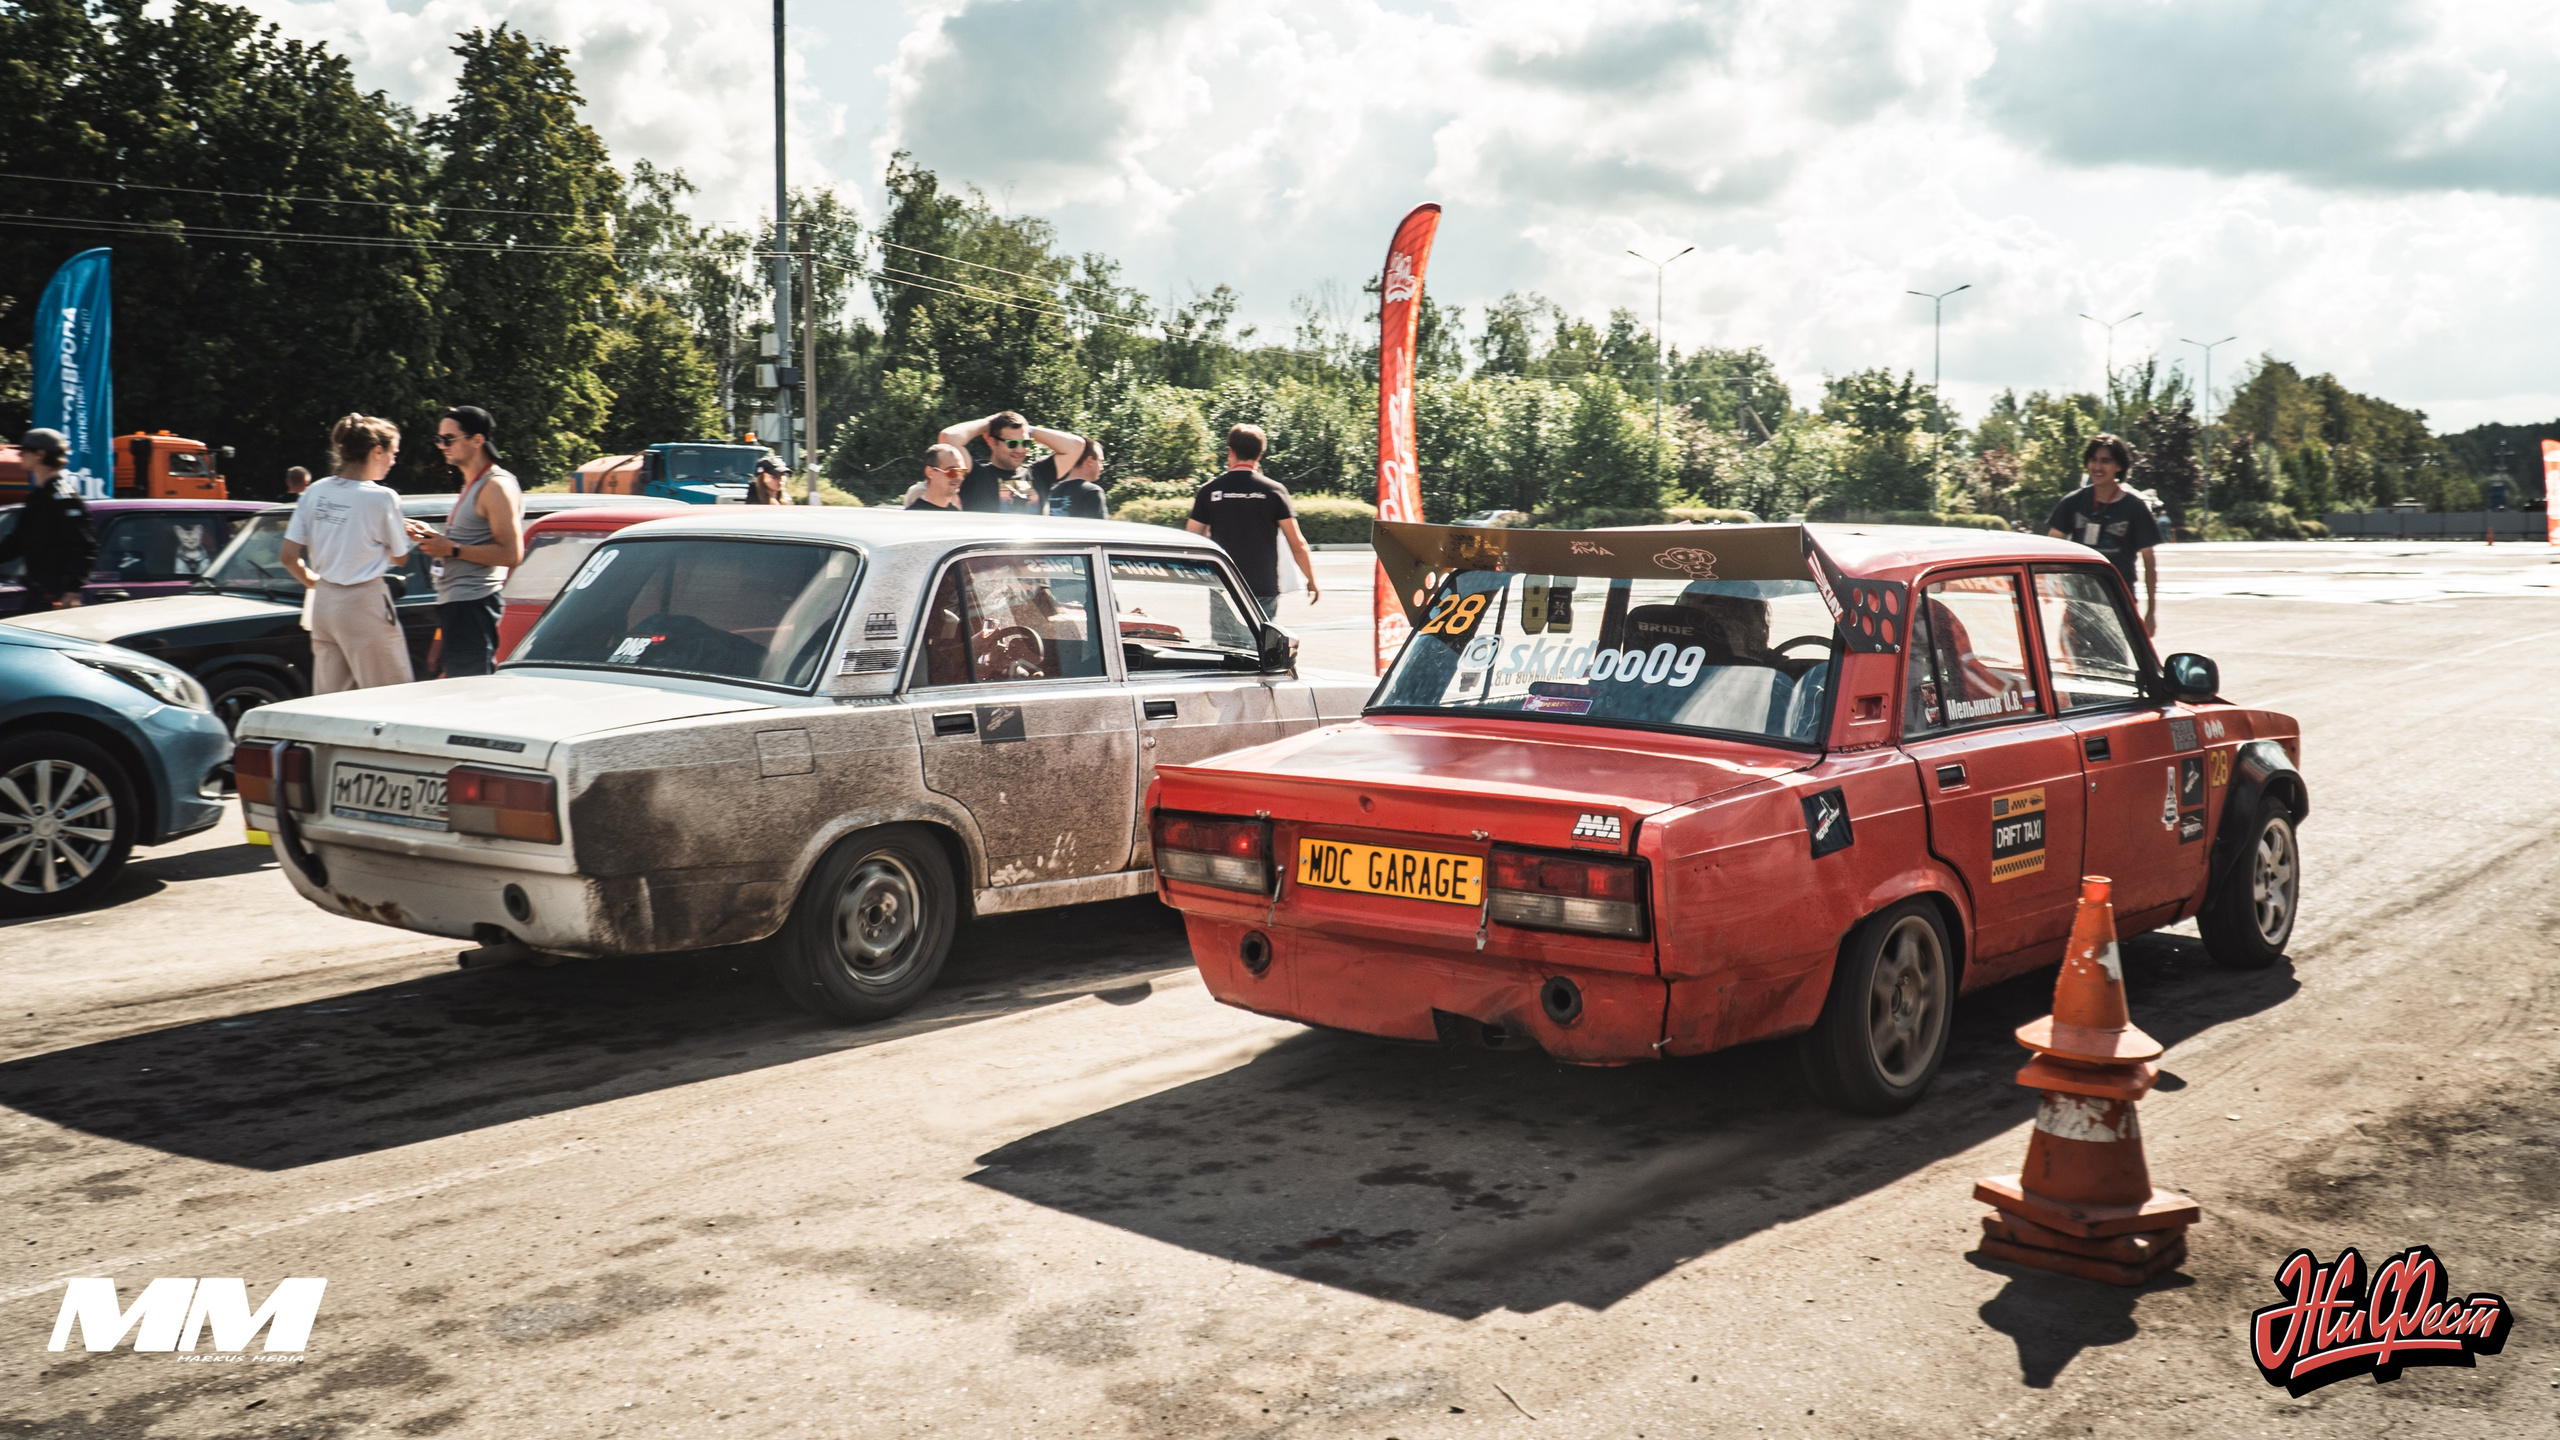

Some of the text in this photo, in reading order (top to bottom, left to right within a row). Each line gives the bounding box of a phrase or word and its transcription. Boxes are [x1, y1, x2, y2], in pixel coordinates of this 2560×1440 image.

[1421, 594, 1487, 634] 28
[1638, 621, 1696, 636] BRIDE
[613, 637, 652, 656] DNB
[1502, 637, 1706, 688] skidoo09
[1946, 697, 2002, 720] Мельников
[2003, 691, 2023, 712] О.В.
[2211, 749, 2229, 788] 28
[1996, 819, 2042, 849] DRIFT TAXI
[1309, 843, 1469, 899] MDC GARAGE
